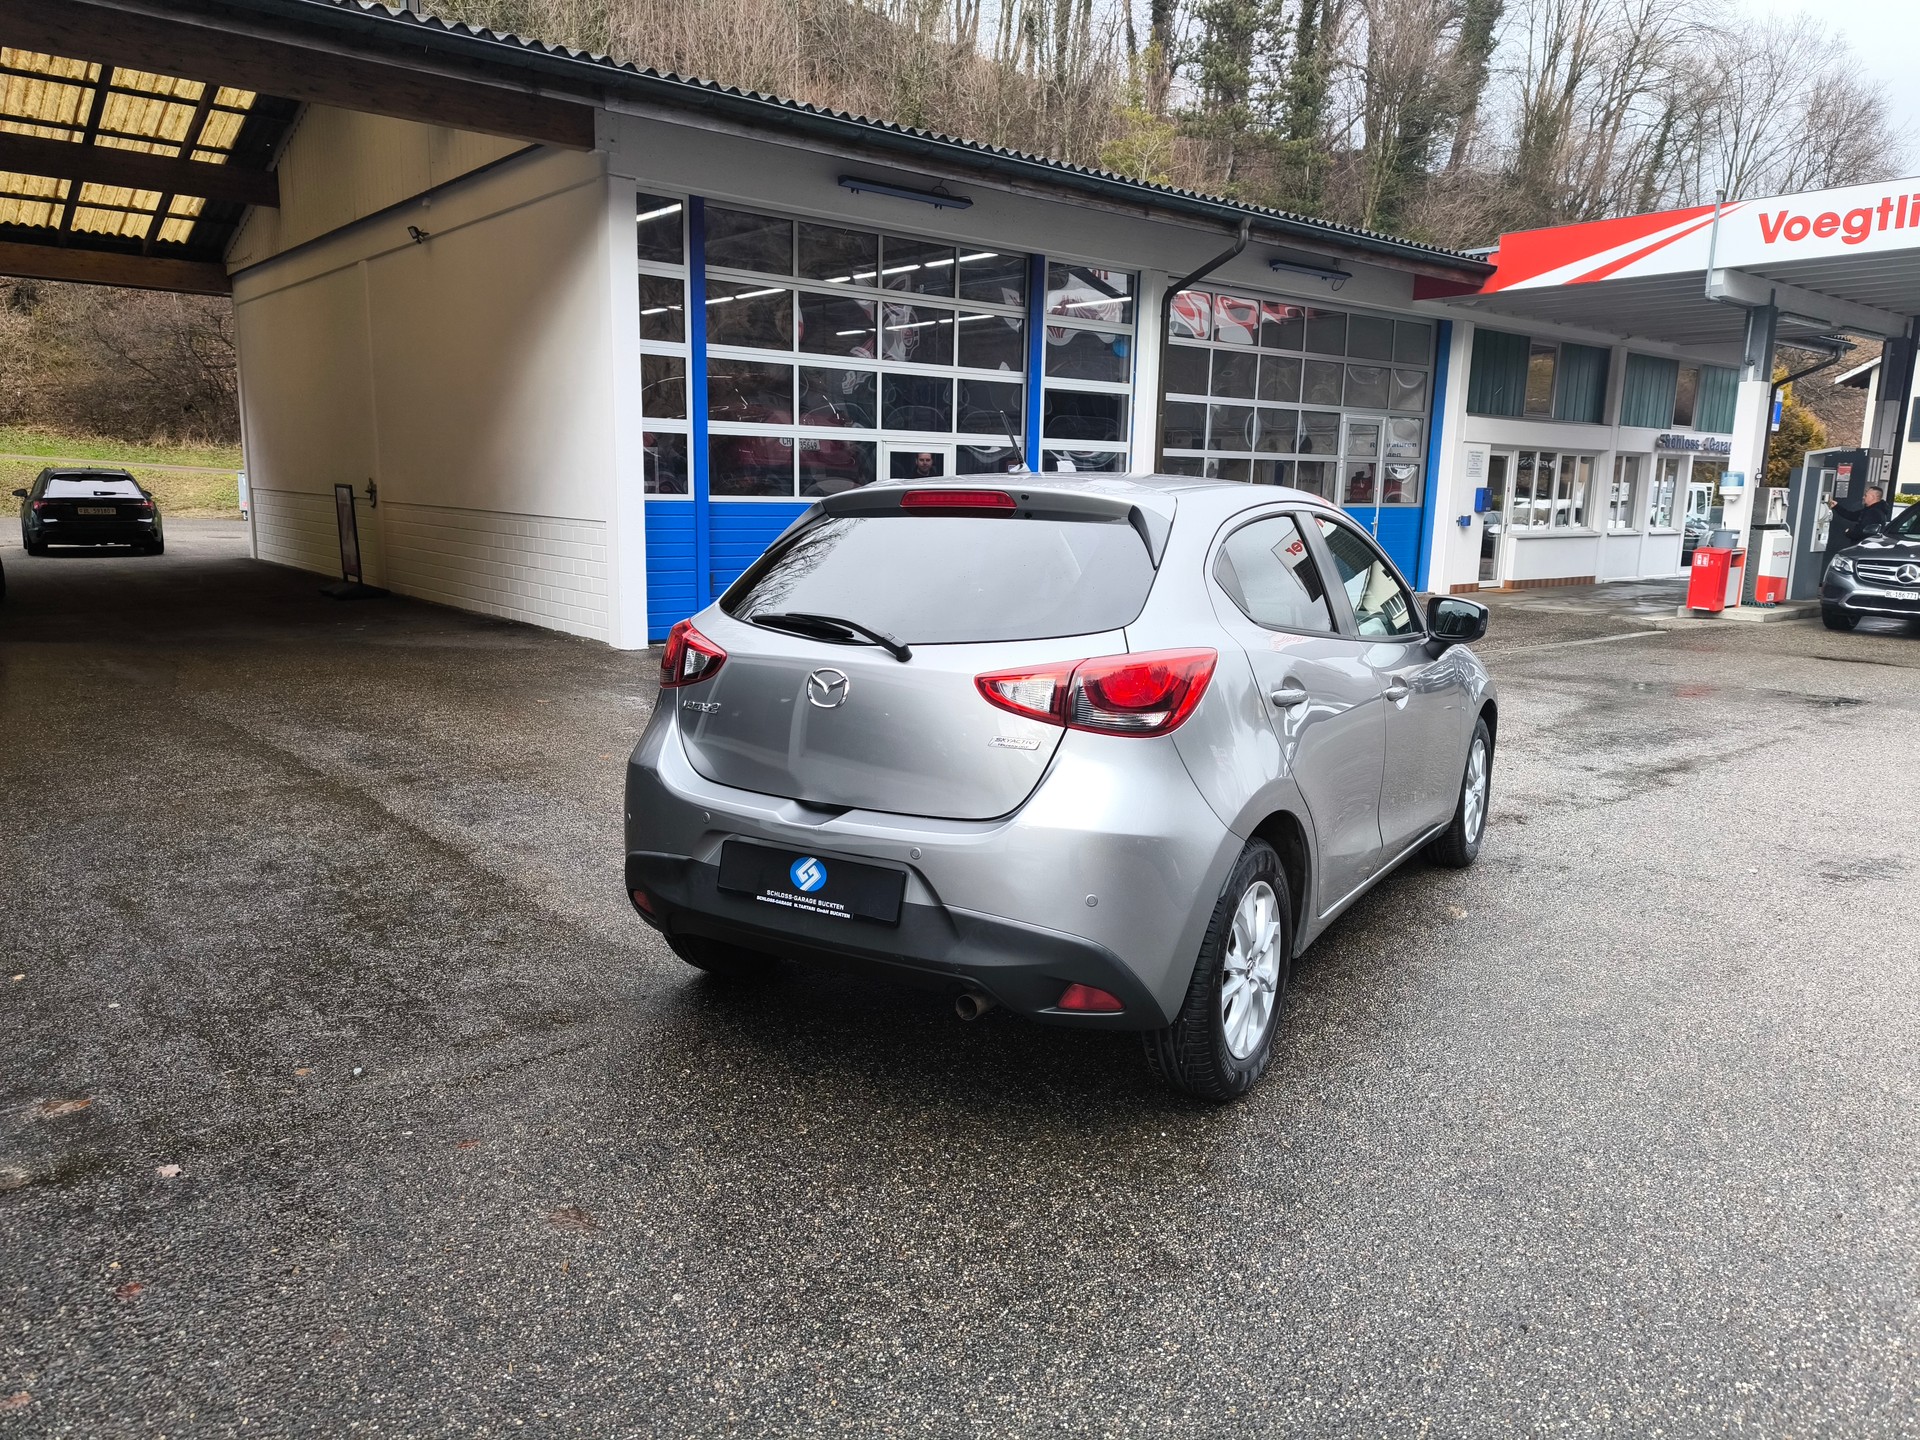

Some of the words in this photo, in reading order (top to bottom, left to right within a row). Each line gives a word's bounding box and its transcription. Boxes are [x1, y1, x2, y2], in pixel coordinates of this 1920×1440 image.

[1758, 193, 1920, 245] Voegtli
[1660, 434, 1699, 450] Schloss
[1709, 437, 1731, 453] Gara
[766, 889, 816, 905] SCHLOSS-GARAGE
[817, 899, 845, 911] BUCKTEN
